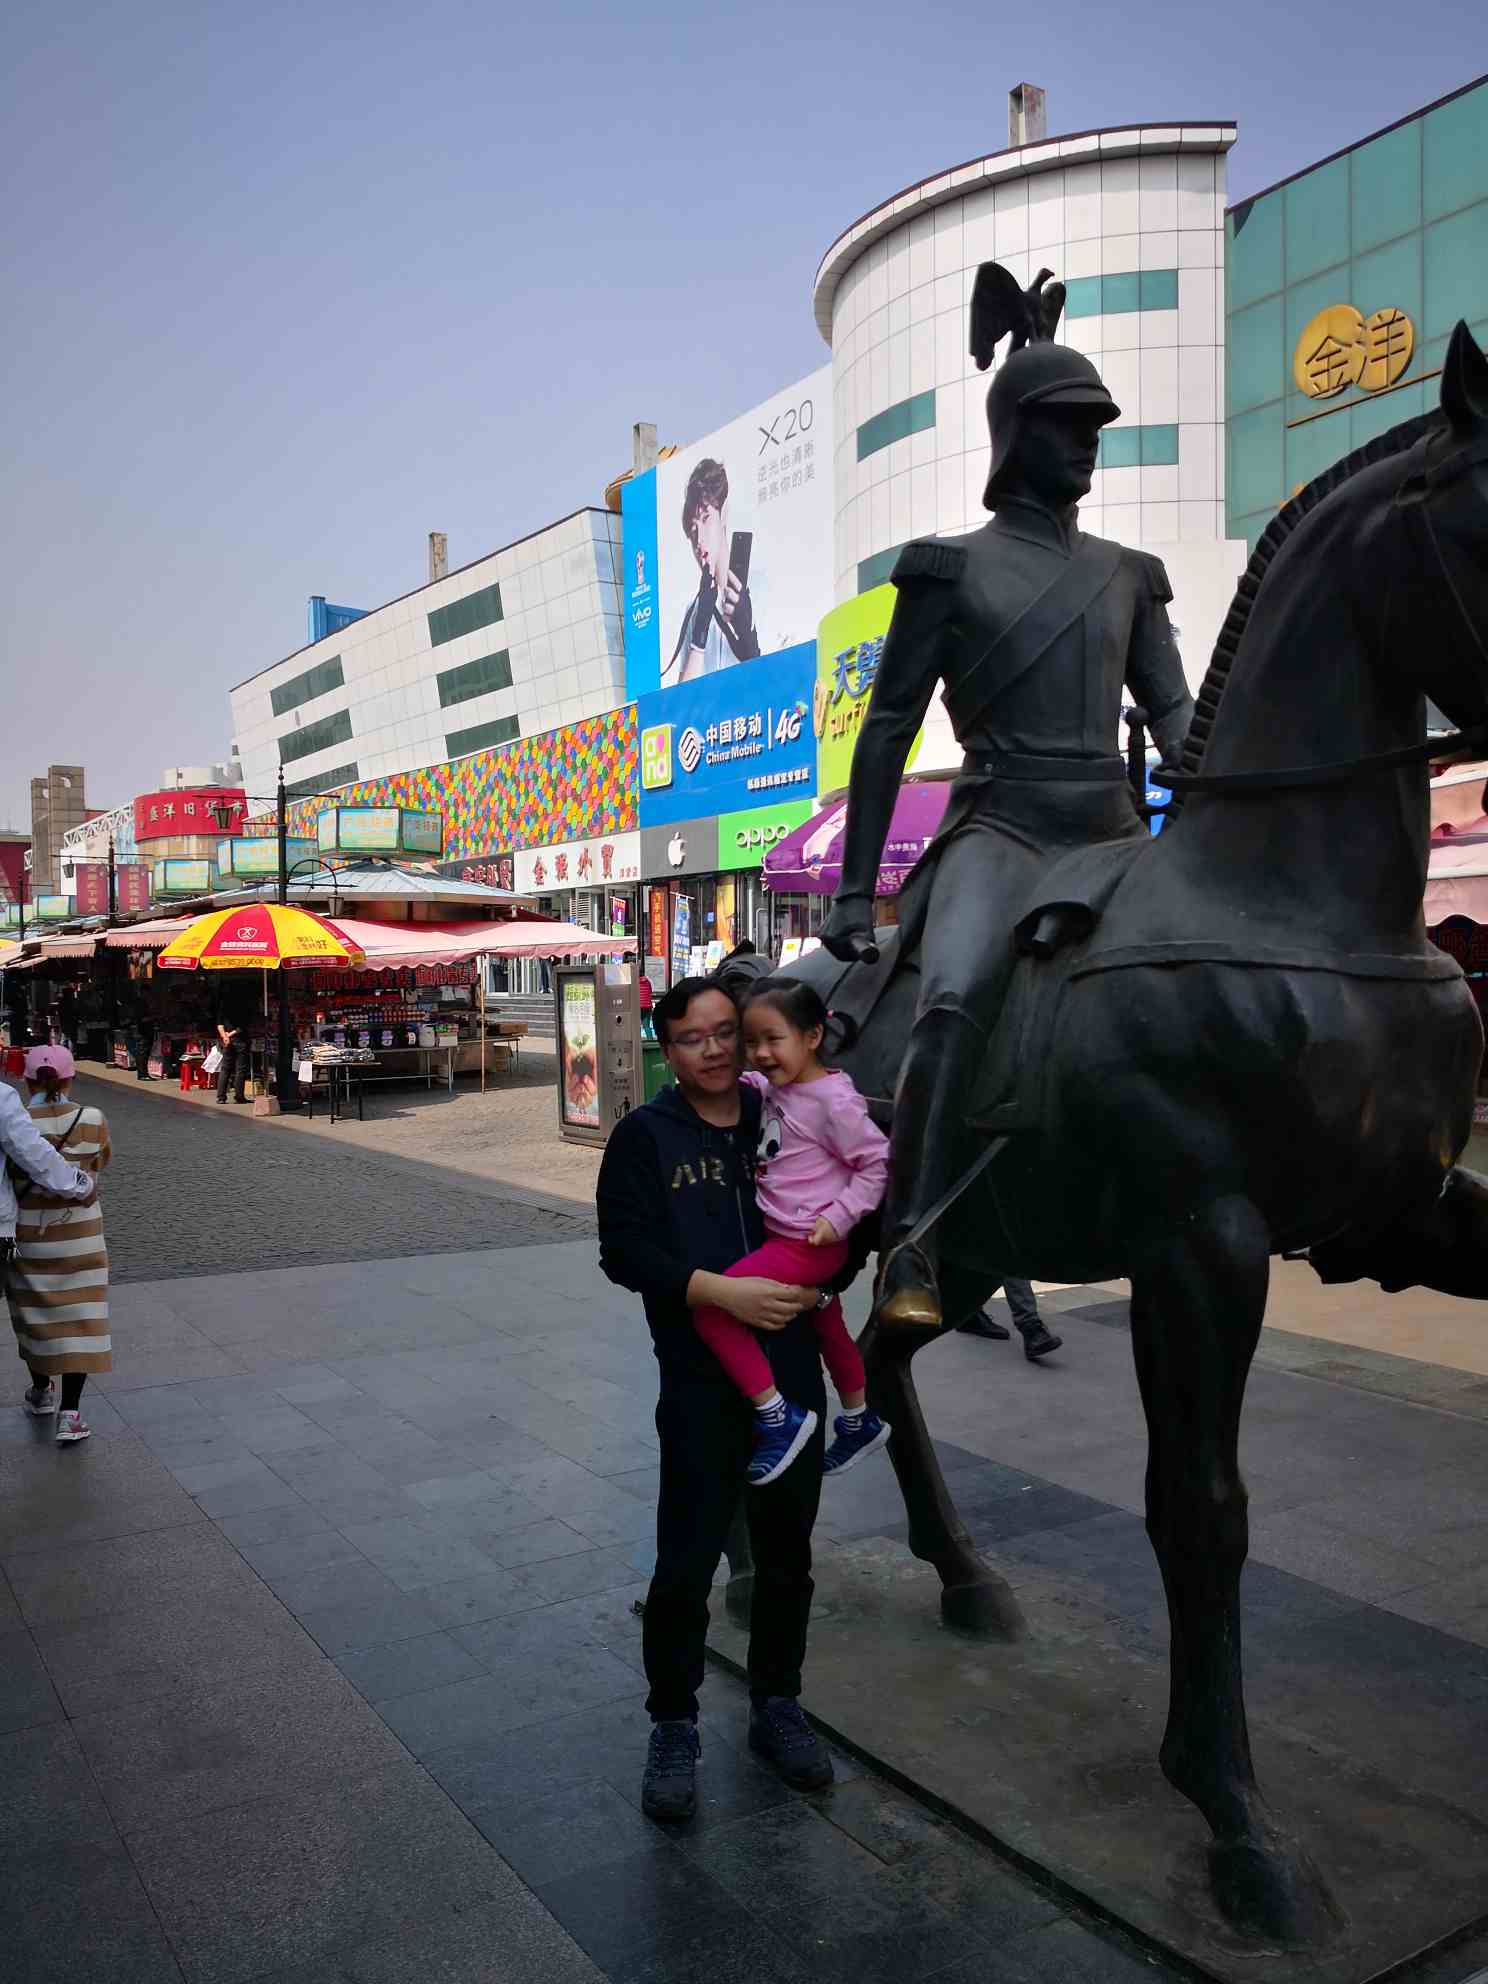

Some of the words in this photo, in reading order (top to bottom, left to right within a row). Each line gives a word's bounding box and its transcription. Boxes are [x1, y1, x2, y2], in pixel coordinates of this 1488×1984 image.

[1300, 307, 1408, 399] 金洋
[758, 399, 814, 456] X20
[631, 606, 652, 622] vivo
[706, 711, 763, 747] 中国移动
[775, 708, 802, 744] 4G
[706, 751, 731, 766] China
[731, 743, 762, 761] Mobile
[735, 824, 790, 849] oppo
